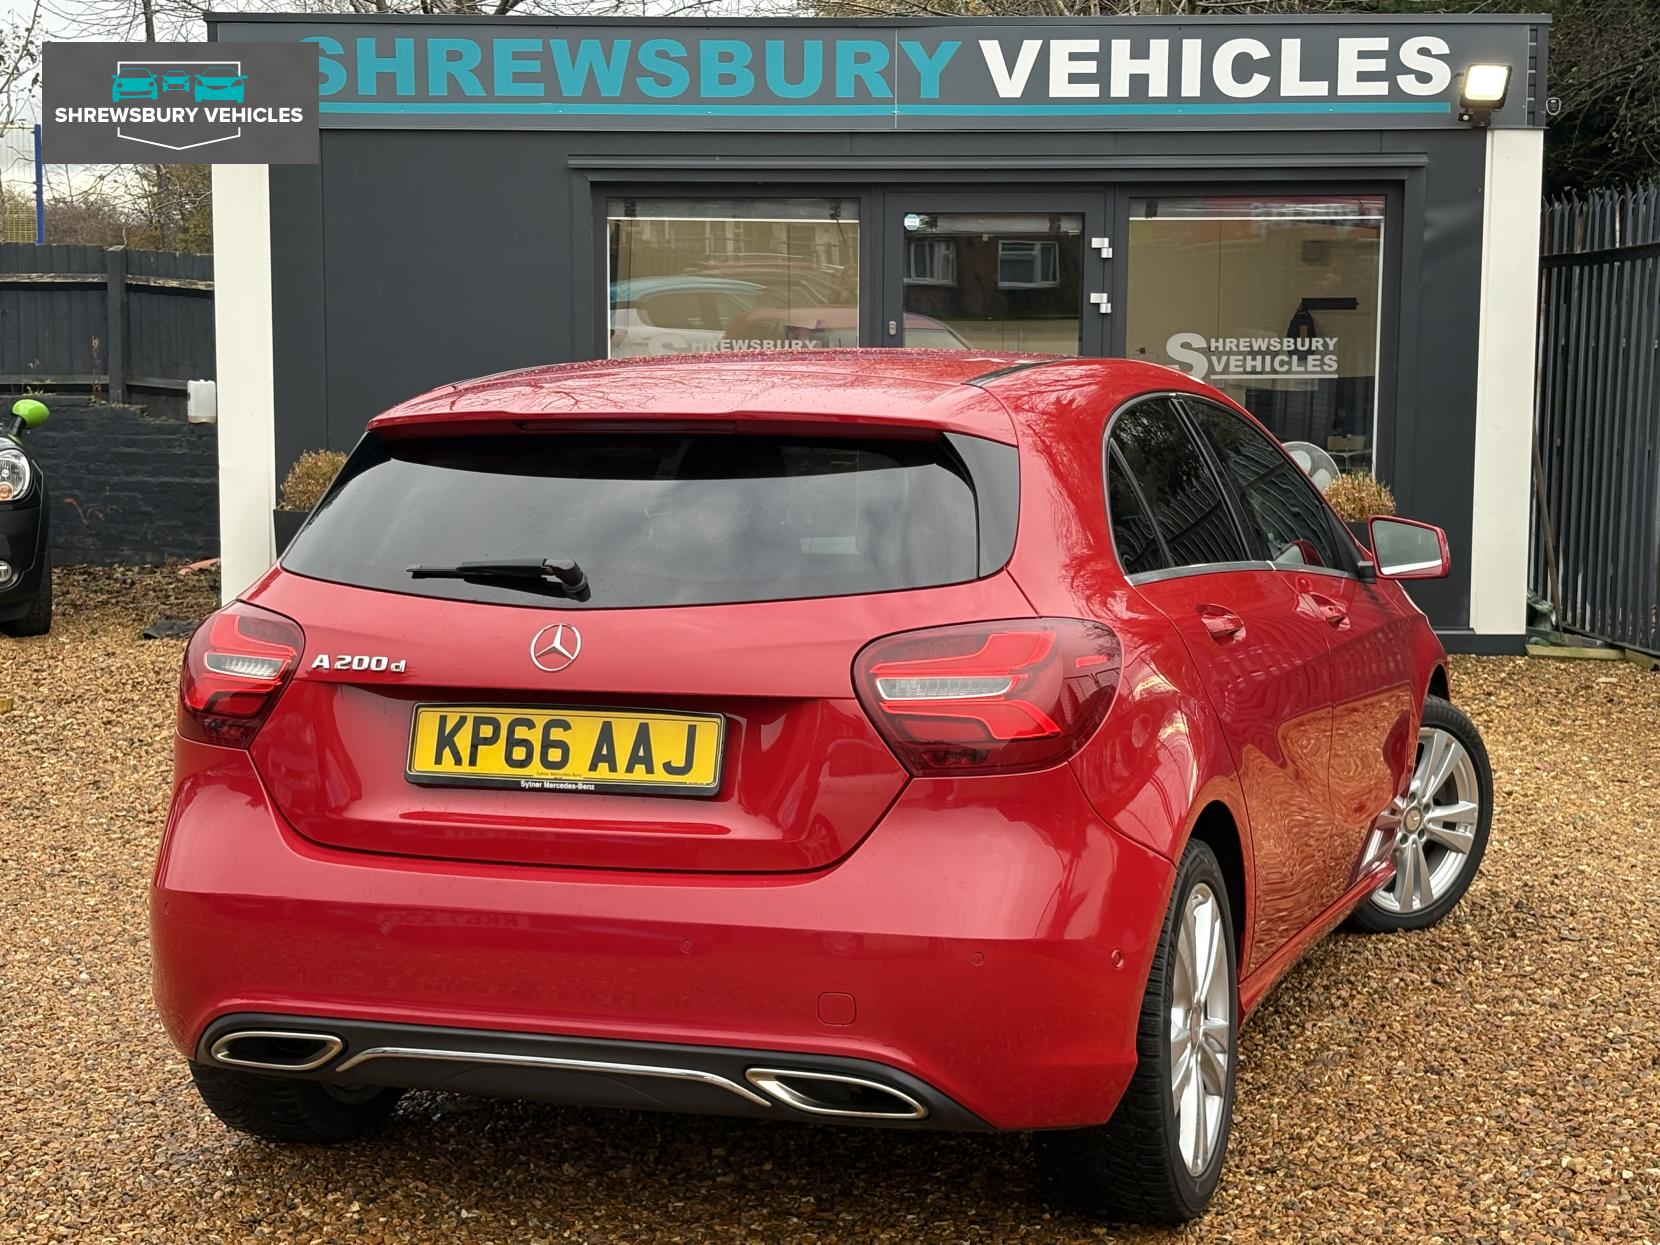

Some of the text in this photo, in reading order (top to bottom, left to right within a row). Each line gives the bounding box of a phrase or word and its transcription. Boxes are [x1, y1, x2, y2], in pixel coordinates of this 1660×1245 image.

[299, 36, 1452, 98] SHREWSBURY VEHICLES
[1210, 355, 1338, 372] VEHICLES
[434, 715, 697, 775] KP66 AAJ
[520, 781, 596, 790] Sytner Mercedes-Benz
